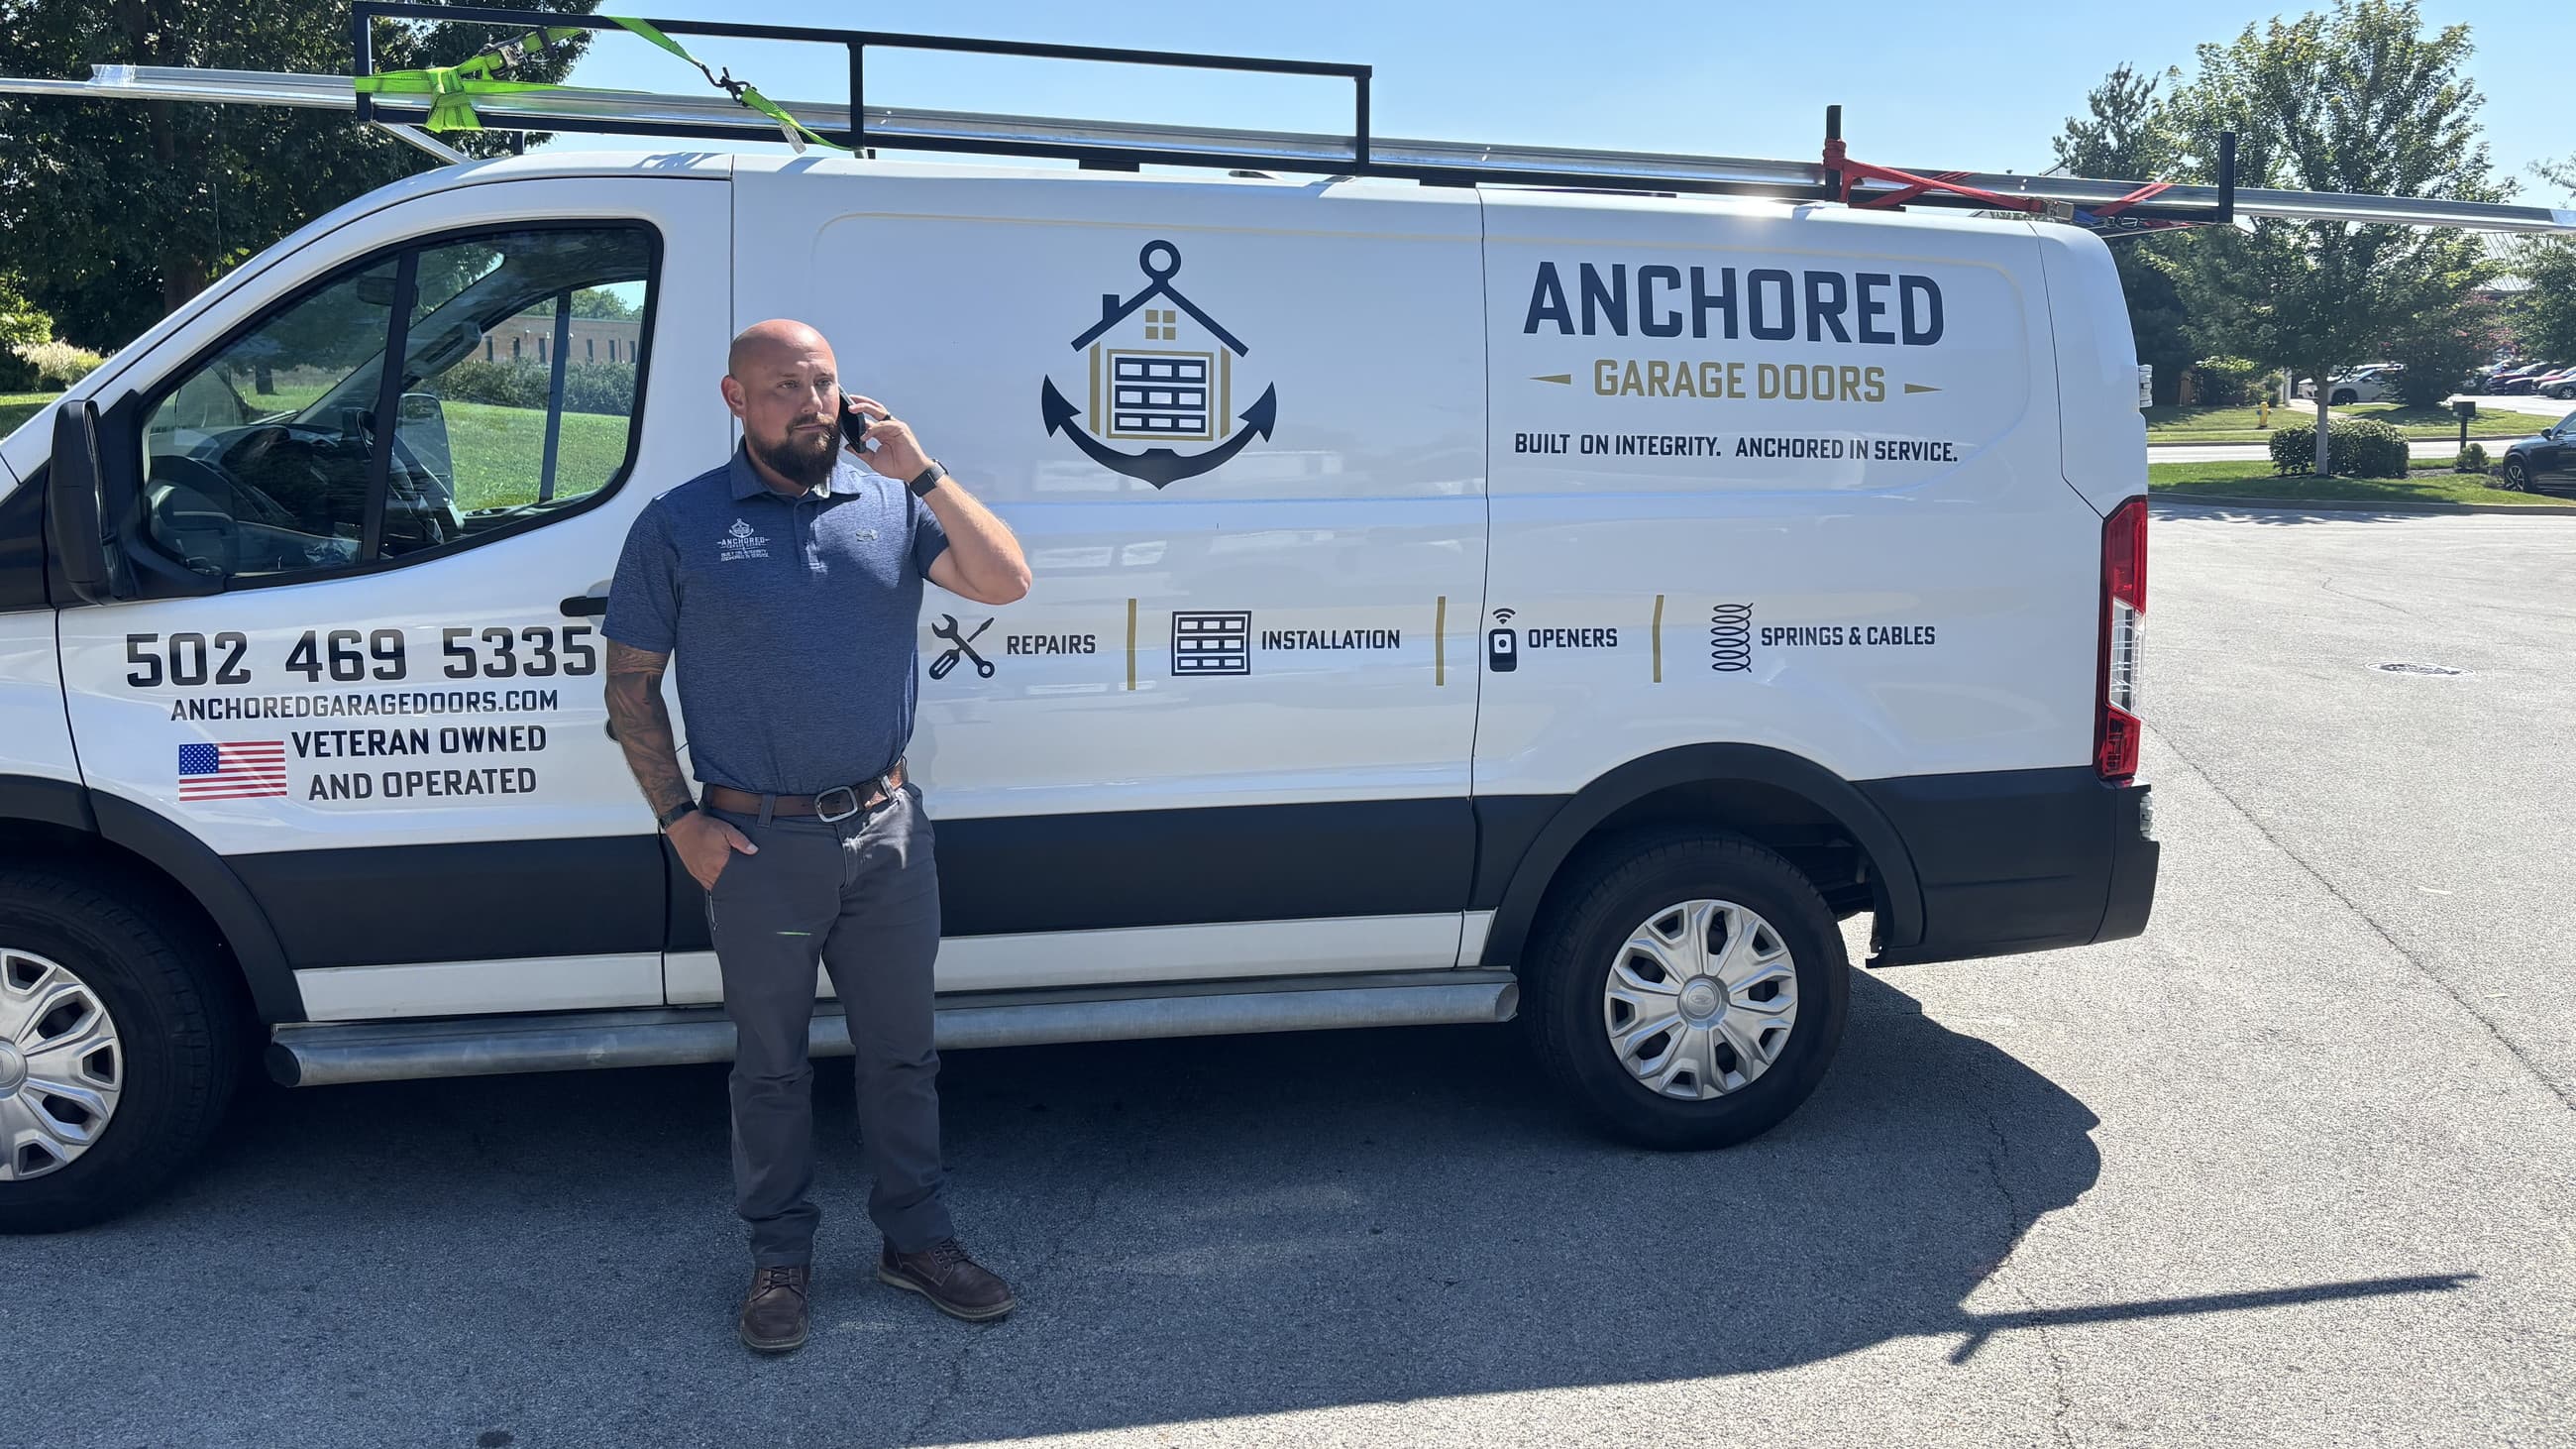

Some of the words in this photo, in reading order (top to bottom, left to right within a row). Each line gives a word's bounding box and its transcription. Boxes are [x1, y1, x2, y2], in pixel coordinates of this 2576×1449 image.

[1523, 261, 1945, 346] ANCHORED
[1594, 359, 1747, 398] GARAGE
[1758, 363, 1886, 402] DOORS
[1515, 433, 1570, 454] BUILT
[1580, 434, 1609, 455] ON
[1615, 435, 1721, 457] INTEGRITY.
[1735, 437, 1844, 459] ANCHORED
[1850, 439, 1869, 460] IN
[1874, 440, 1958, 462] SERVICE.
[1006, 634, 1096, 655] REPAIRS
[1261, 629, 1401, 650] INSTALLATION
[1528, 627, 1618, 648] OPENERS
[1761, 626, 1843, 647] SPRINGS
[1849, 627, 1863, 646] &
[1867, 625, 1936, 646] CABLES
[127, 631, 252, 688] 502
[285, 628, 407, 683] 469
[442, 625, 596, 680] 5335
[170, 689, 558, 722] ANCHOREDGARAGEDOORS.COM
[291, 727, 430, 758] VETERAN
[440, 724, 547, 754] OWNED
[309, 772, 373, 801] AND
[382, 767, 537, 798] OPERATED
